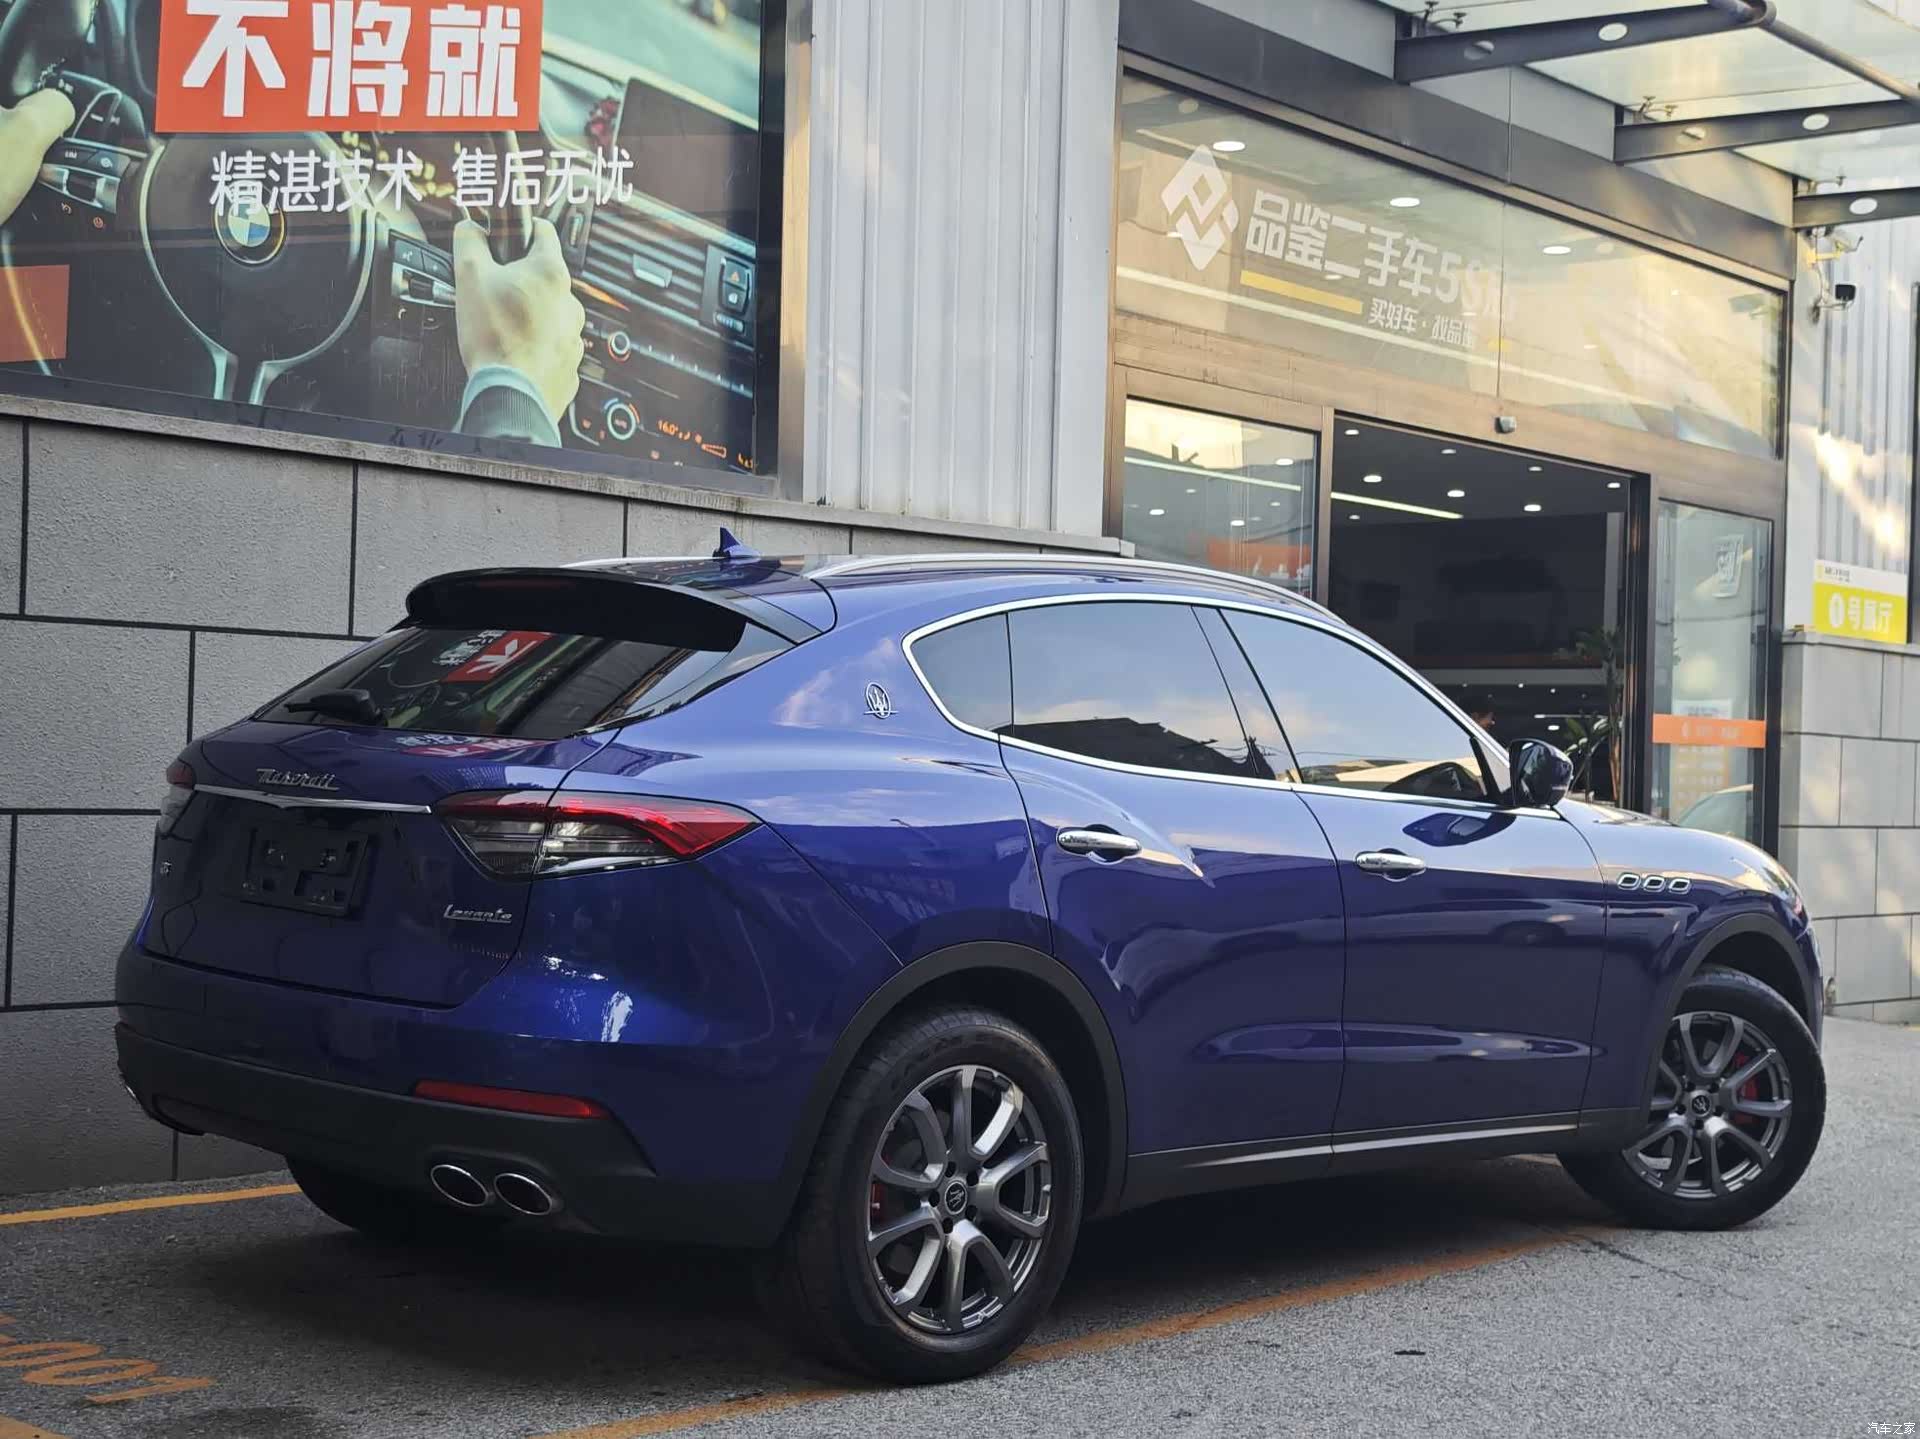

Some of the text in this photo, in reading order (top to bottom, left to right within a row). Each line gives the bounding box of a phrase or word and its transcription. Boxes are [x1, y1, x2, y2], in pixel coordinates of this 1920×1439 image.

[182, 1, 521, 118] 不将就
[209, 146, 635, 216] 精湛技术 售后无忧
